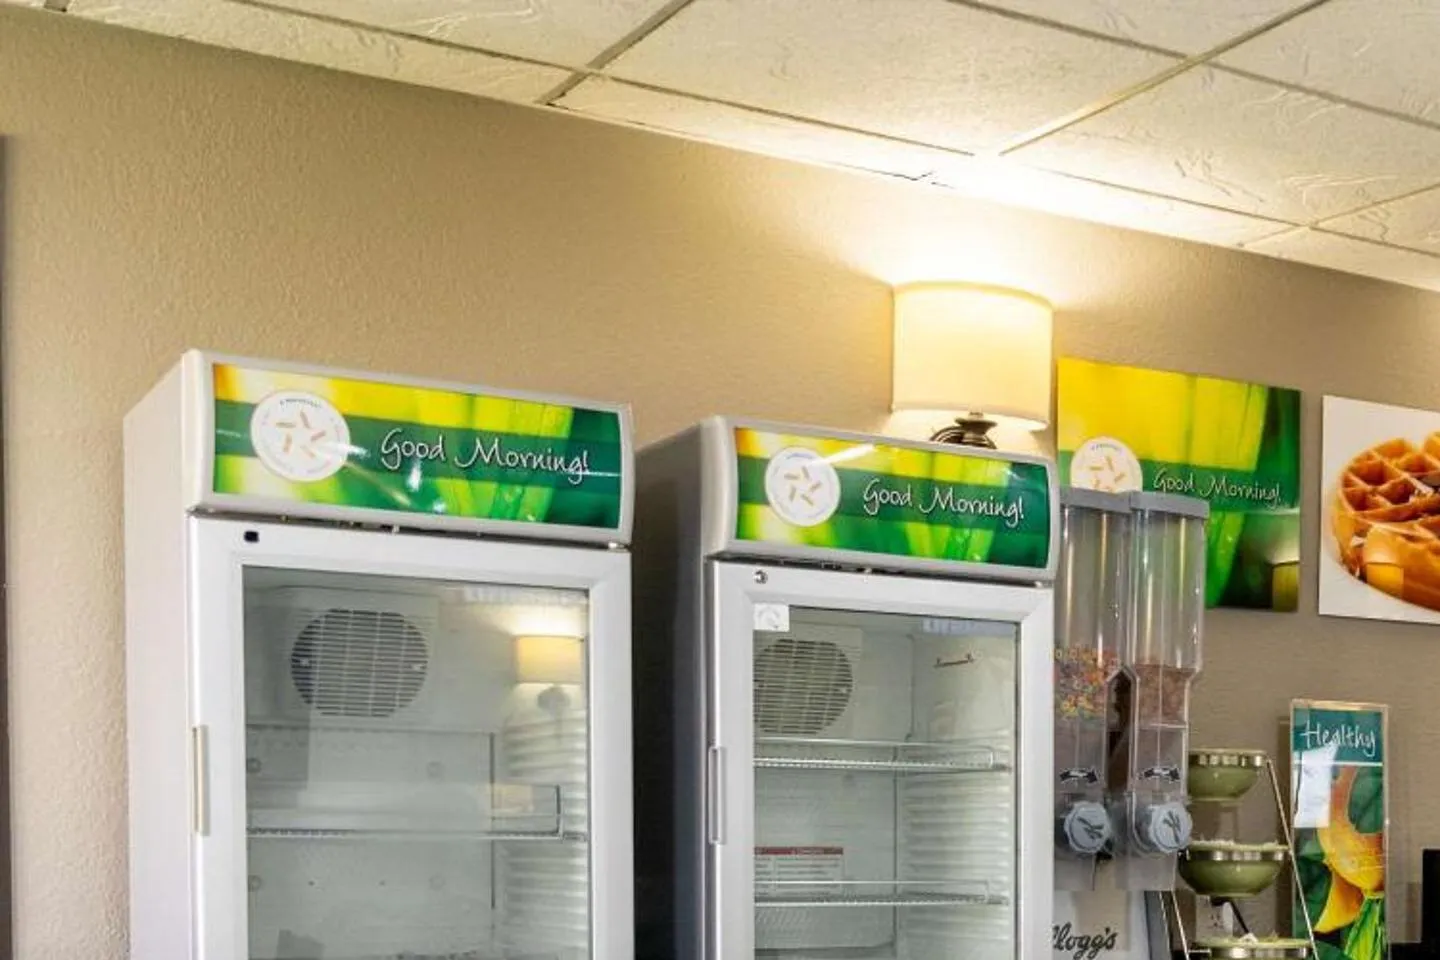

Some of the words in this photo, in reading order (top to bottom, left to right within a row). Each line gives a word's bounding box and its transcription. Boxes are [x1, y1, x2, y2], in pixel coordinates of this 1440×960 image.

[381, 427, 446, 471] Good
[454, 437, 591, 485] Morning!
[863, 477, 913, 516] Good
[919, 486, 1025, 529] Morning!
[1152, 466, 1195, 493] Good
[1199, 475, 1281, 510] Morning!
[1299, 718, 1376, 758] Healthy
